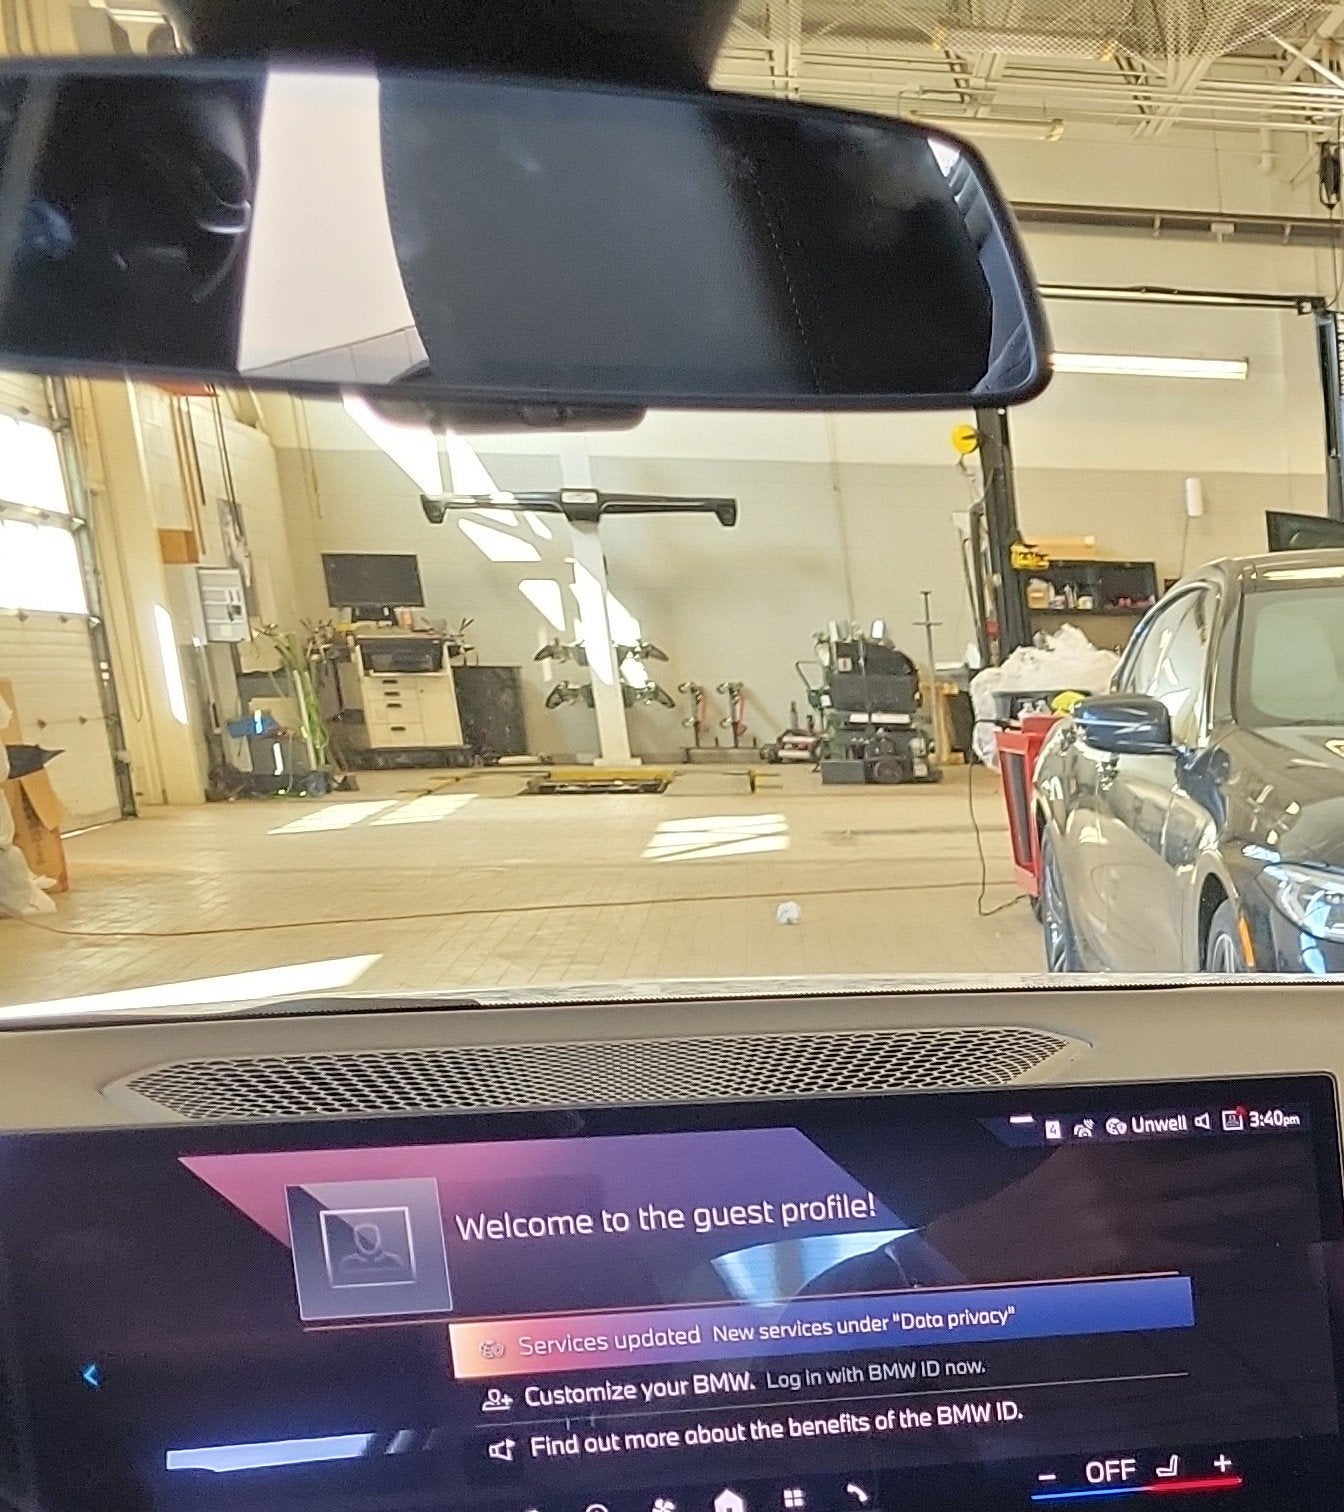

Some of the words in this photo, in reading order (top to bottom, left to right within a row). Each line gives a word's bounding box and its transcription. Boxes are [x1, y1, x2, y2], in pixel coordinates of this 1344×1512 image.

[1131, 1114, 1188, 1133] Unwell
[1249, 1110, 1300, 1128] 3:40pm
[455, 1212, 594, 1240] Welcome
[601, 1209, 630, 1232] to
[638, 1204, 686, 1230] the
[693, 1200, 774, 1232] guest
[780, 1192, 877, 1227] profile!
[713, 1325, 755, 1342] New
[759, 1319, 833, 1340] services
[837, 1313, 889, 1334] under
[892, 1312, 944, 1331] "Data
[948, 1306, 1016, 1330] privacy"
[518, 1333, 609, 1356] Services
[614, 1325, 702, 1351] updated
[524, 1379, 637, 1407] Customize
[641, 1379, 690, 1402] your
[693, 1371, 756, 1394] BMW.
[766, 1370, 801, 1391] Log
[826, 1365, 865, 1384] with
[869, 1360, 917, 1382] BMW
[921, 1360, 940, 1377] ID
[945, 1360, 987, 1376] now.
[530, 1433, 580, 1457] Find
[584, 1433, 621, 1454] out
[625, 1429, 681, 1450] more
[684, 1422, 747, 1443] about
[750, 1422, 785, 1441] the
[788, 1412, 871, 1437] benefits
[875, 1408, 897, 1431] of
[900, 1407, 933, 1429] the
[937, 1402, 991, 1426] BMW
[995, 1400, 1024, 1421] ID.
[1085, 1457, 1137, 1484] OFF
